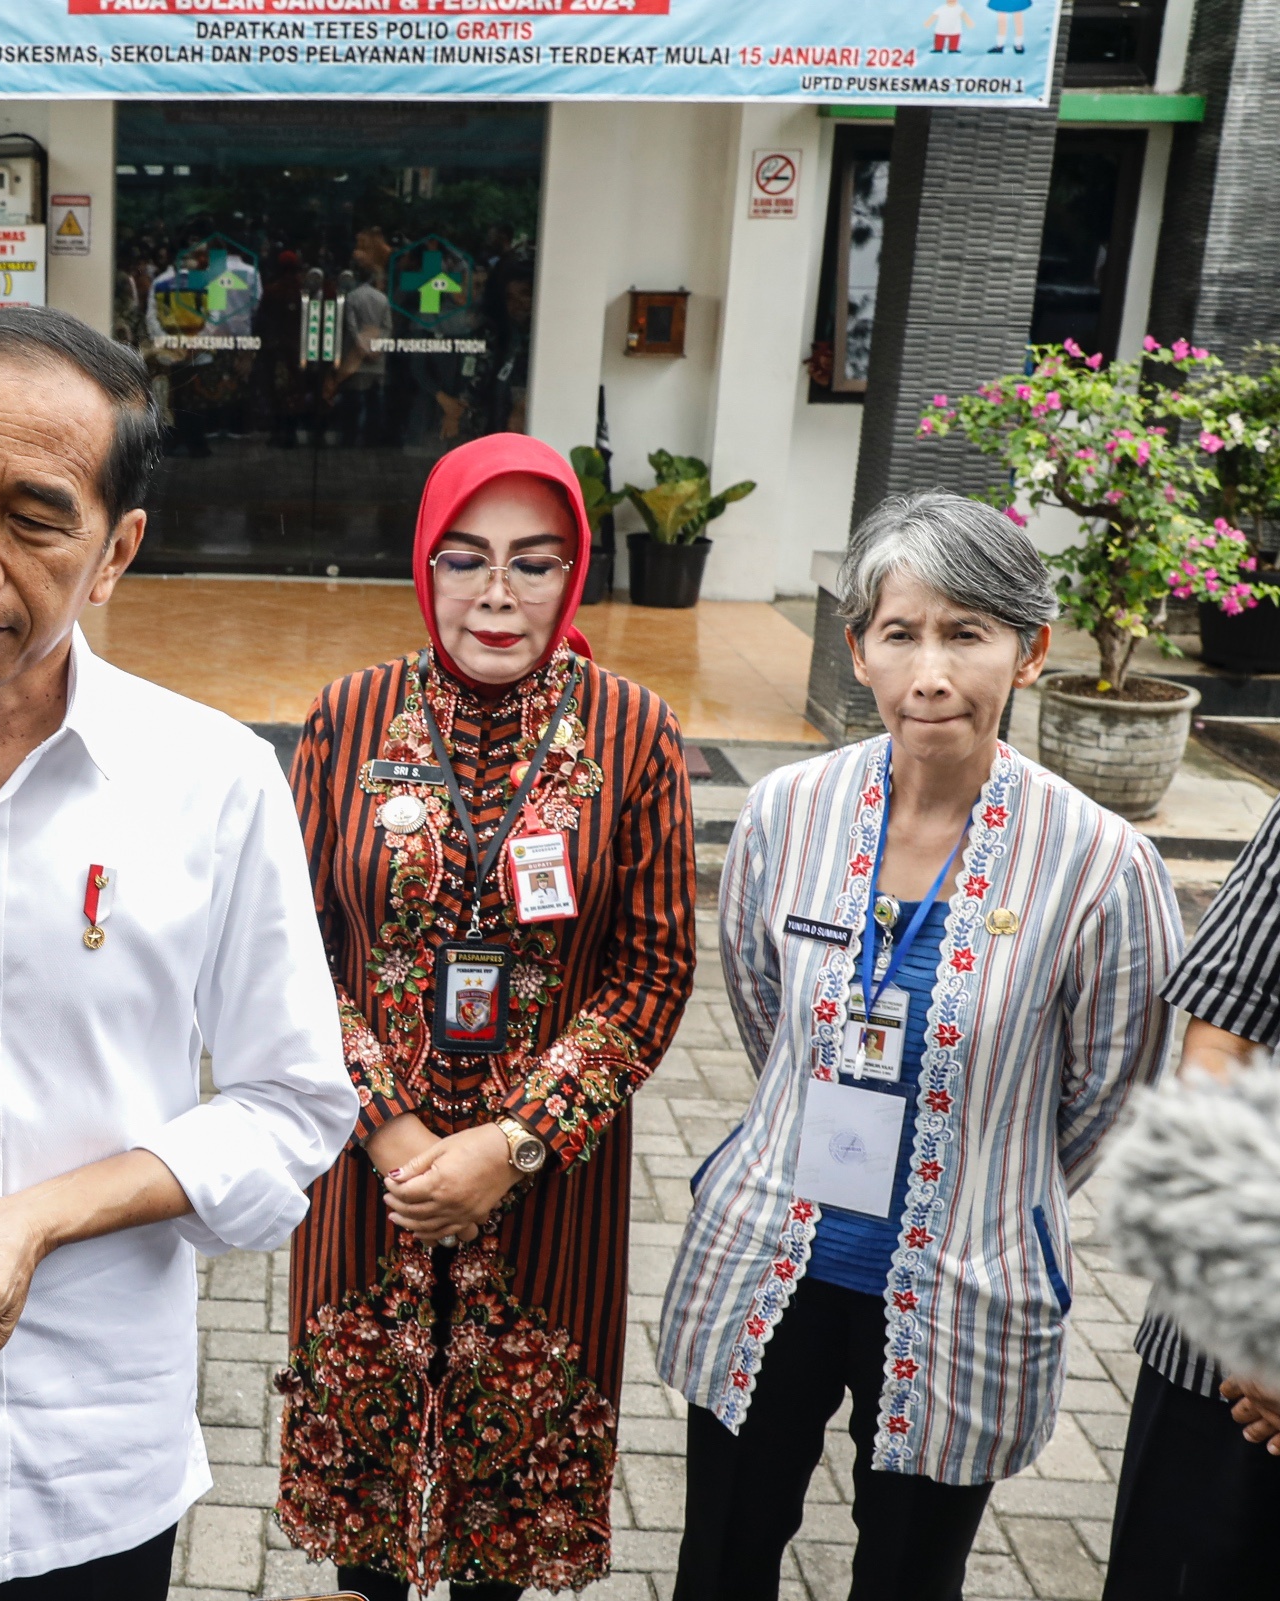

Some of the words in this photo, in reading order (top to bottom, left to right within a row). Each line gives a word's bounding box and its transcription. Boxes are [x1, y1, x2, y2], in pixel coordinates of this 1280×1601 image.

[196, 21, 305, 39] DAPATKAN
[313, 21, 378, 39] TETES
[386, 21, 449, 40] POLIO
[456, 21, 533, 40] GRATIS
[111, 45, 204, 63] SEKOLAH
[212, 45, 251, 63] DAN
[259, 45, 299, 63] POS
[306, 45, 426, 63] PELAYANAN
[434, 46, 541, 64] IMUNISASI
[549, 46, 658, 64] TERDEKAT
[665, 47, 730, 65] MULAI
[738, 47, 762, 66] 15
[769, 47, 859, 67] JANUARI
[865, 49, 916, 68] 2024
[801, 76, 842, 90] UPTD
[846, 77, 950, 92] PUSKESMAS
[955, 78, 1010, 93] TOROH
[1014, 79, 1024, 93] 1
[10, 245, 16, 255] 1
[393, 765, 409, 776] SRI
[411, 767, 421, 778] S.
[528, 861, 553, 870] BUPATI
[787, 920, 811, 934] YUNITA
[810, 925, 817, 935] D
[458, 953, 503, 963] PASPAMPRES
